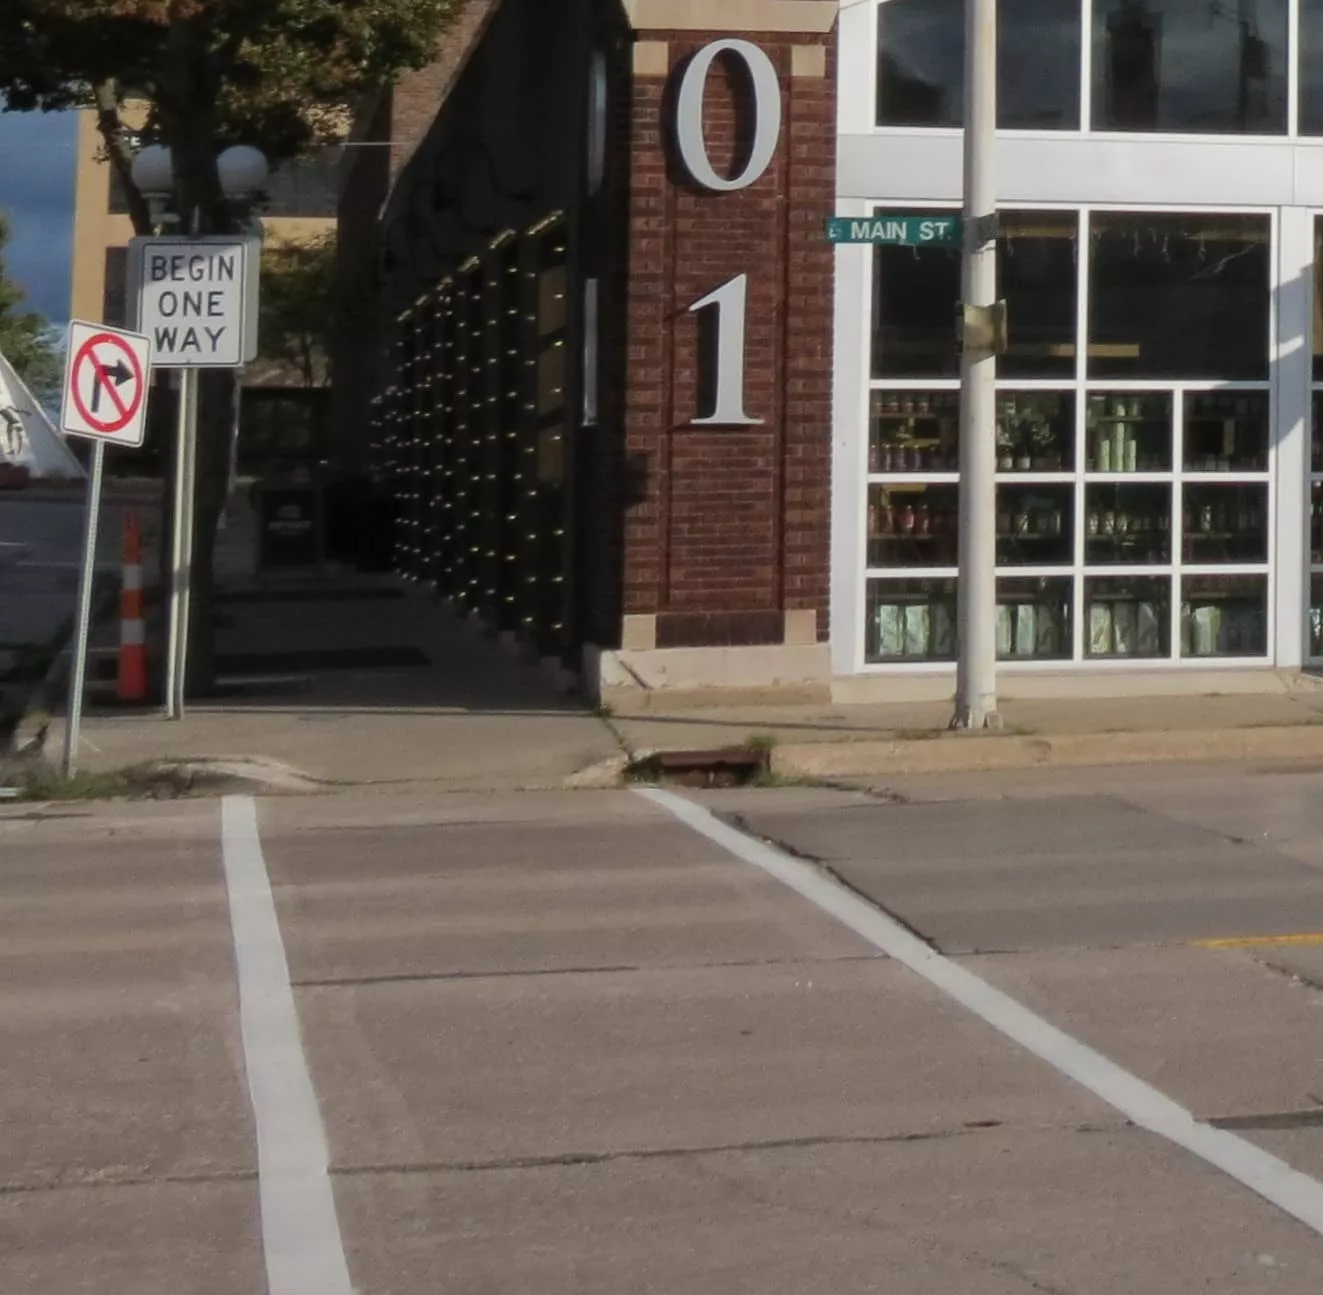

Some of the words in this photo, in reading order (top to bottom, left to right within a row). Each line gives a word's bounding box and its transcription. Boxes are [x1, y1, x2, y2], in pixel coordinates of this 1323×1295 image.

[851, 221, 908, 239] MAIN
[151, 255, 234, 281] BEGIN
[158, 290, 224, 317] ONE
[154, 326, 226, 353] WAY
